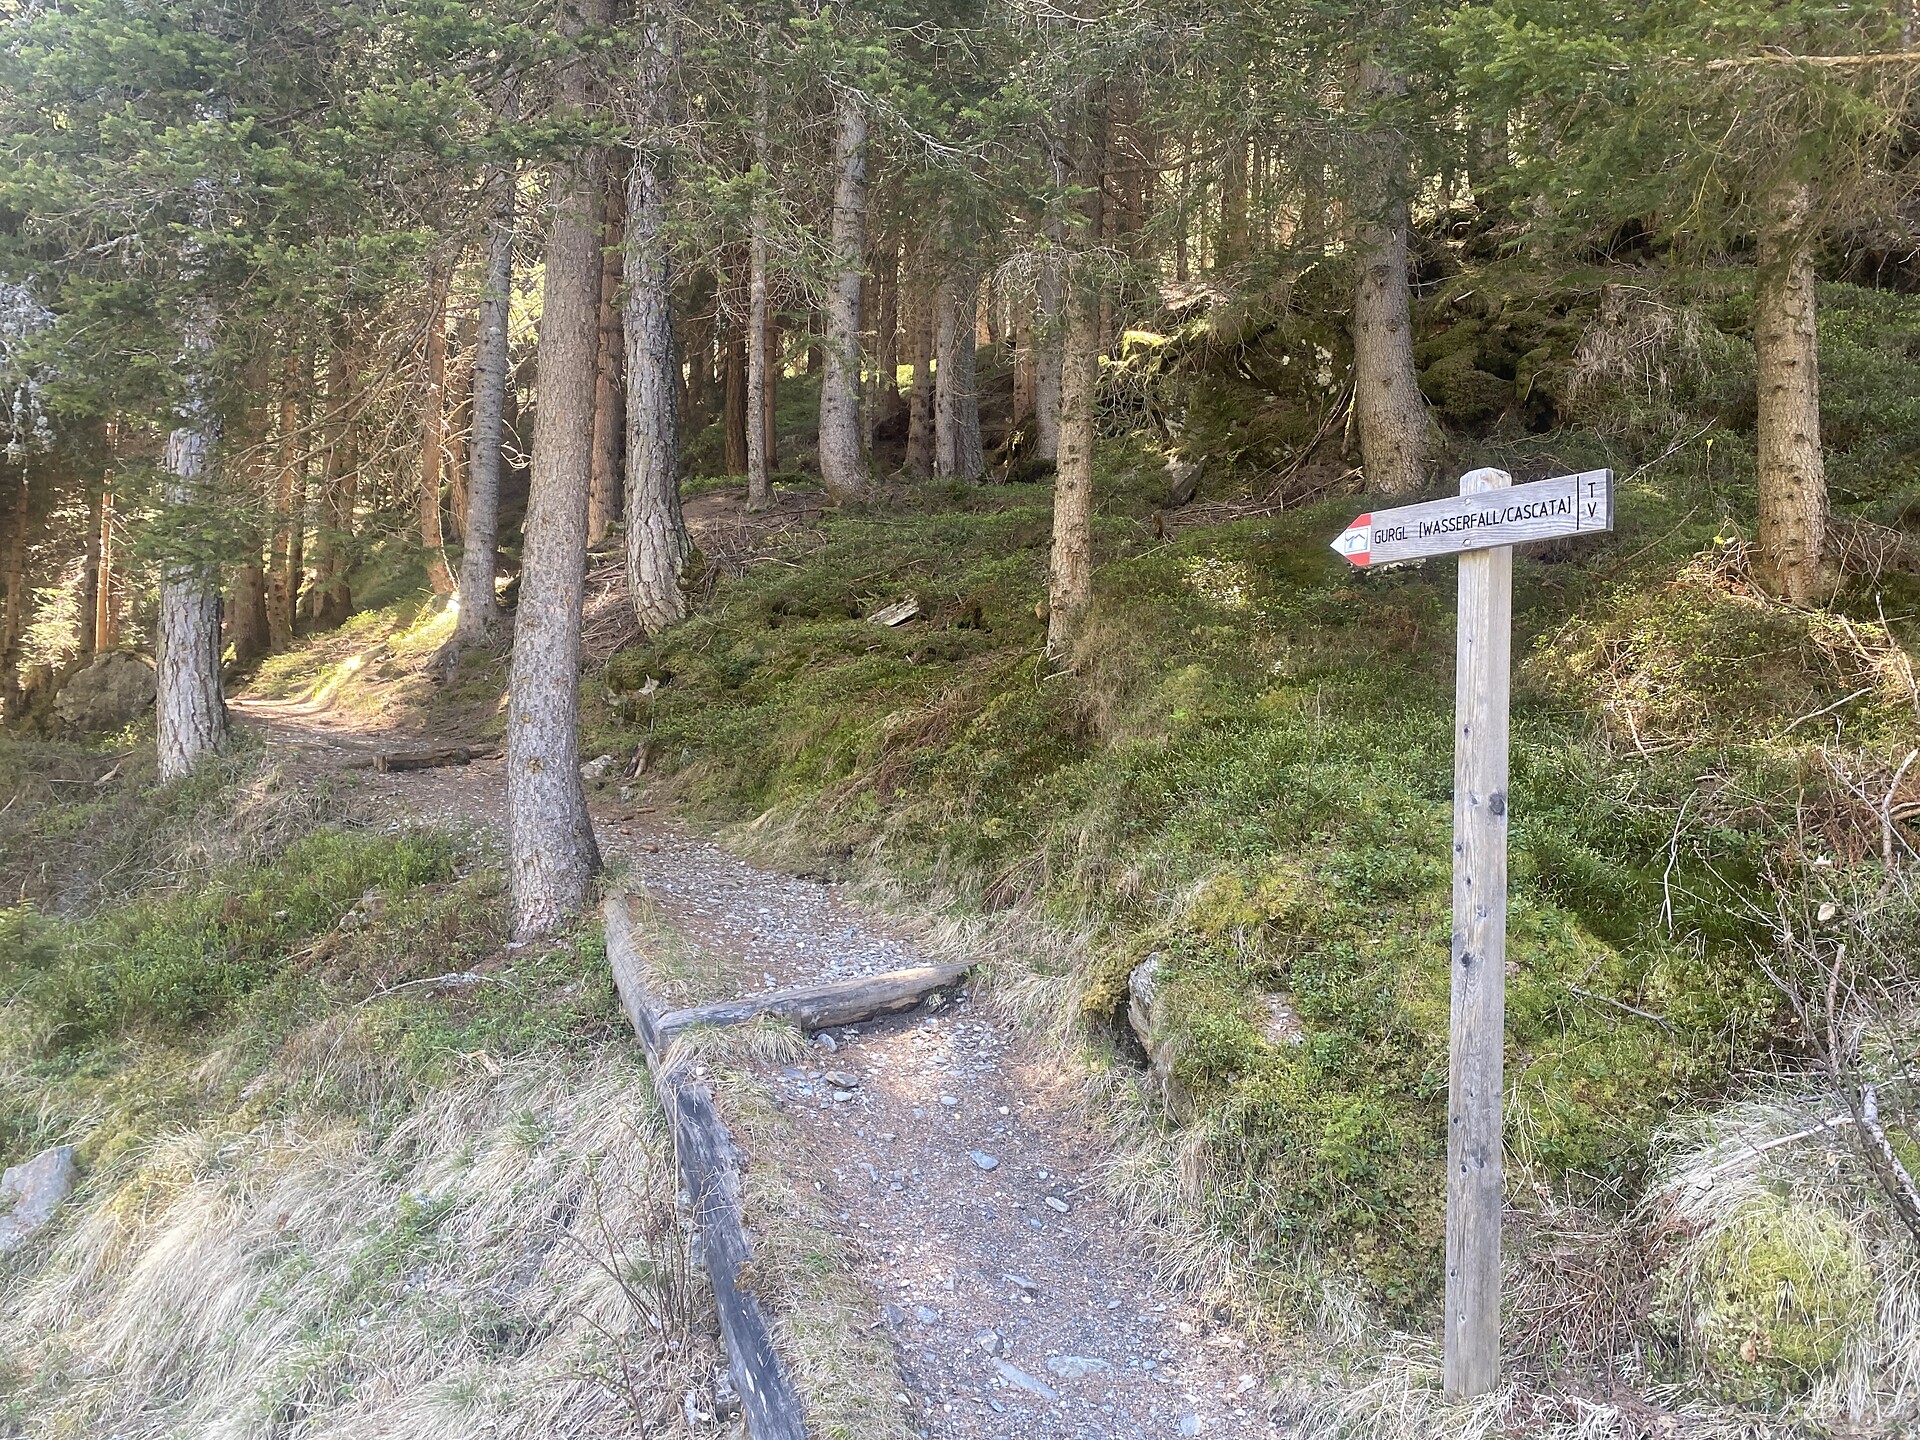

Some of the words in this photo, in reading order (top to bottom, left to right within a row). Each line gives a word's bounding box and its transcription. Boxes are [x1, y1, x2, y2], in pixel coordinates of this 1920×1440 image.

[1587, 482, 1596, 498] T
[1587, 502, 1597, 518] V
[1374, 526, 1408, 544] GURGL
